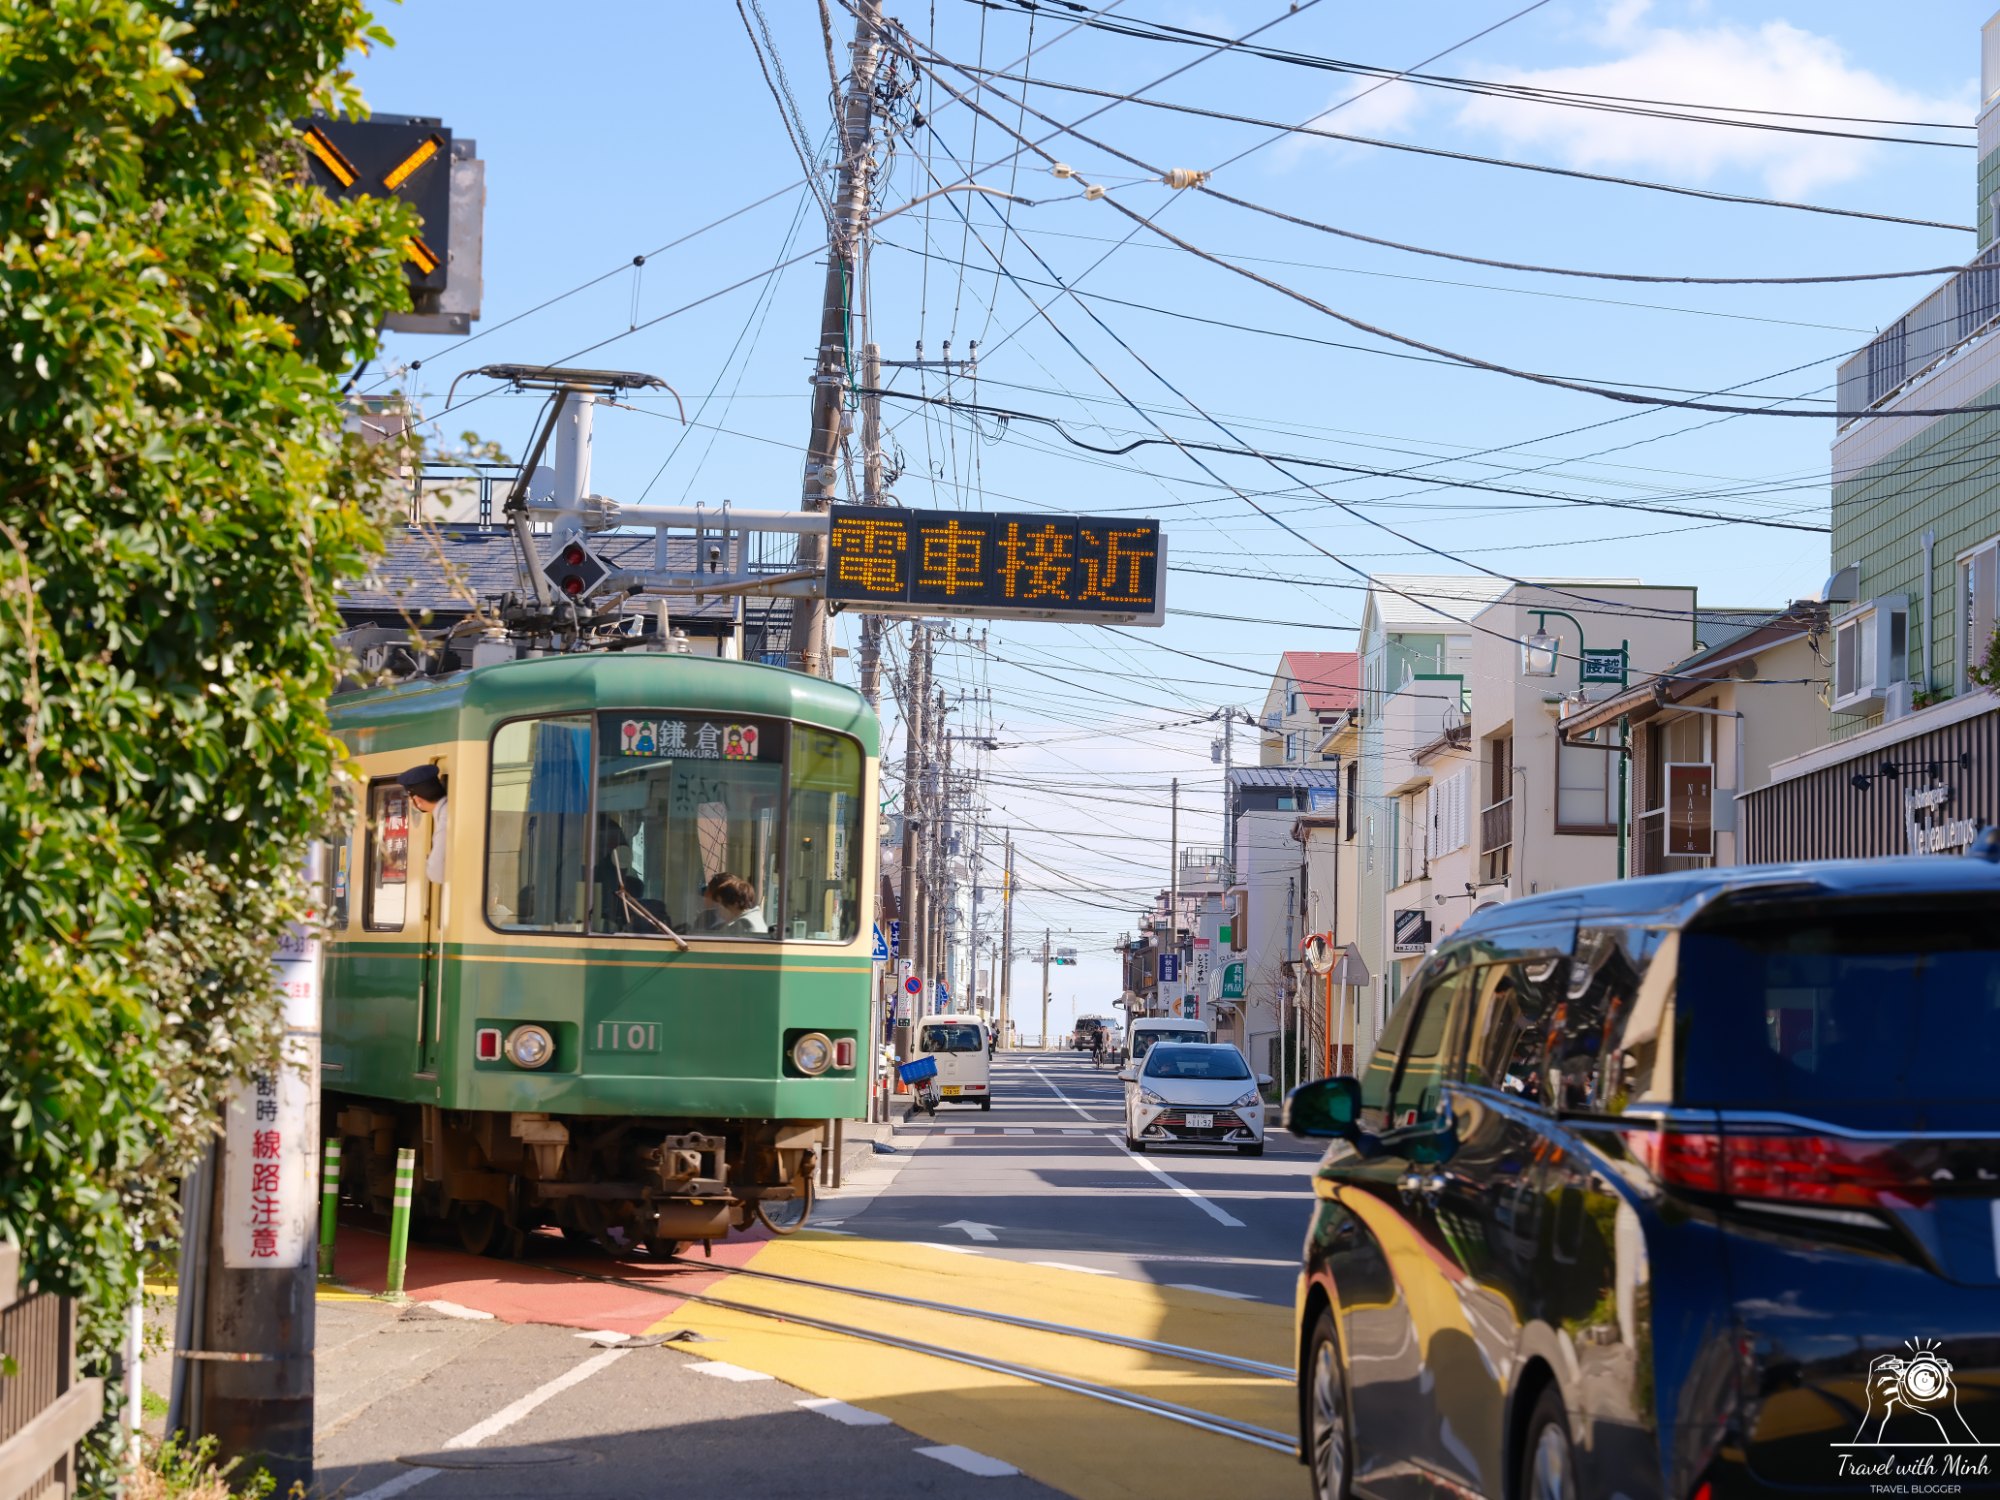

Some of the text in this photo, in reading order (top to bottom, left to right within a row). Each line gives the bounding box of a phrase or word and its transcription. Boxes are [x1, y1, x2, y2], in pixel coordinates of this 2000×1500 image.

[832, 517, 1154, 603] 電車接近
[659, 720, 722, 750] 鎌倉
[659, 747, 720, 759] KAMAKURA
[597, 1023, 655, 1050] 1101
